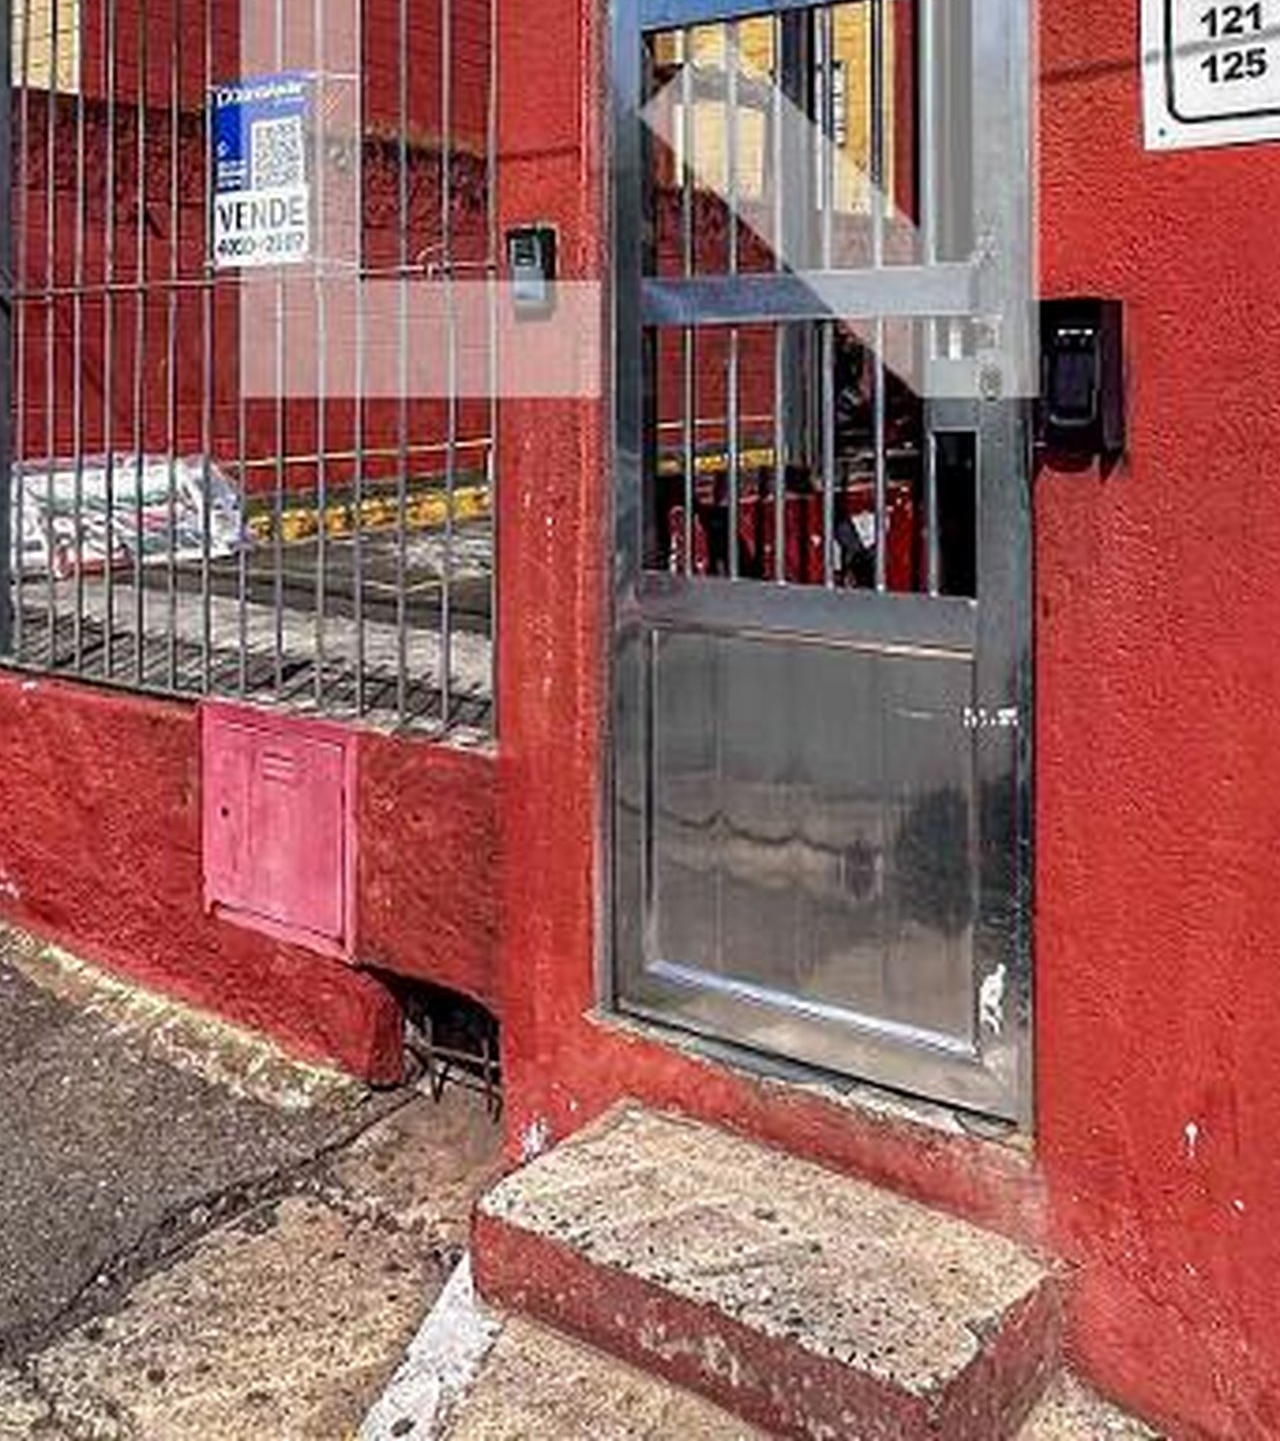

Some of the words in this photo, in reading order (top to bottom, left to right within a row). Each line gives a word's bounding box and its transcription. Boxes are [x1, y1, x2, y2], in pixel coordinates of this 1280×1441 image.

[1200, 3, 1262, 37] 121
[1200, 48, 1267, 83] 125
[218, 198, 305, 233] VENDE
